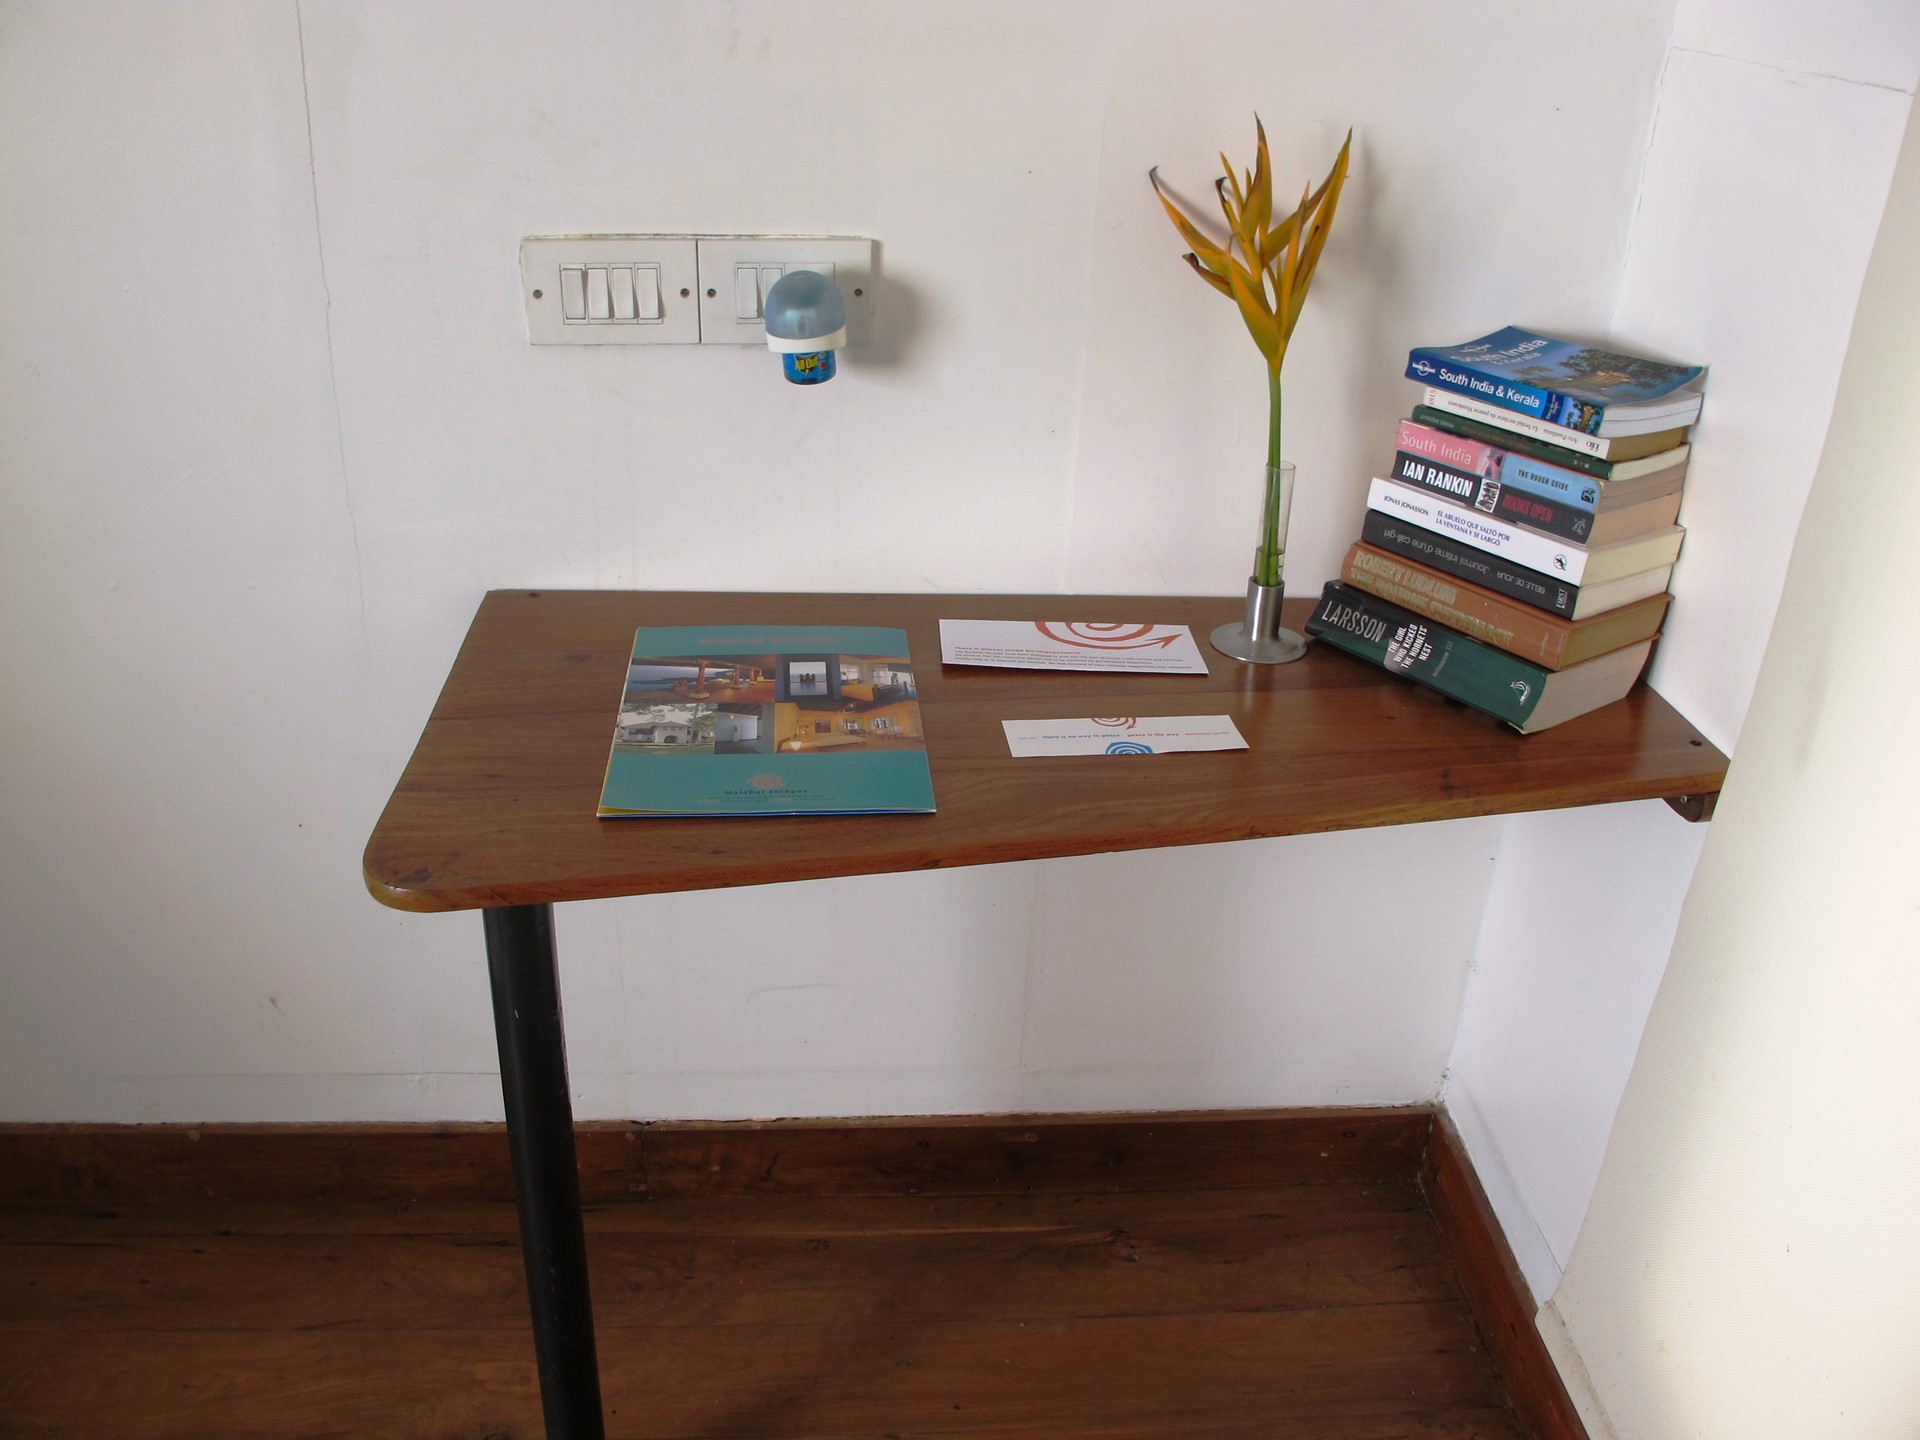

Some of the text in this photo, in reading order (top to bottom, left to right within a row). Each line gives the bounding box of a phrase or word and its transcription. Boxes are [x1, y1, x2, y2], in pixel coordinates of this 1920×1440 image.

[1499, 339, 1549, 357] India
[1438, 368, 1540, 408] South India & Kerala
[1400, 431, 1437, 454] South
[1440, 443, 1472, 465] India
[1402, 460, 1474, 498] IAN RANKIN
[1518, 468, 1569, 491] THE ROUGH GUIDE
[1383, 494, 1429, 516] JONAS JONASSON
[1502, 494, 1555, 523] DOORS OPEN
[1435, 517, 1443, 526] LA
[1443, 519, 1468, 535] VENTANA
[1473, 531, 1480, 539] SE
[1480, 534, 1501, 547] LARGÓ
[1437, 510, 1511, 542] EL ABUELO QUE SALTÓ POR
[1354, 550, 1405, 583] ROBERT
[1383, 528, 1490, 575] Journal intime d'une call-girl
[1350, 566, 1375, 588] THE
[1496, 570, 1546, 595] BELLE DE JOUR
[1555, 587, 1565, 610] FIRST
[1321, 600, 1387, 643] LARSSON
[1388, 626, 1408, 654] THE GIRL
[1392, 623, 1418, 663] WHO KICKED
[1400, 624, 1428, 669] THE HORNETS'
[1418, 642, 1433, 662] NEST
